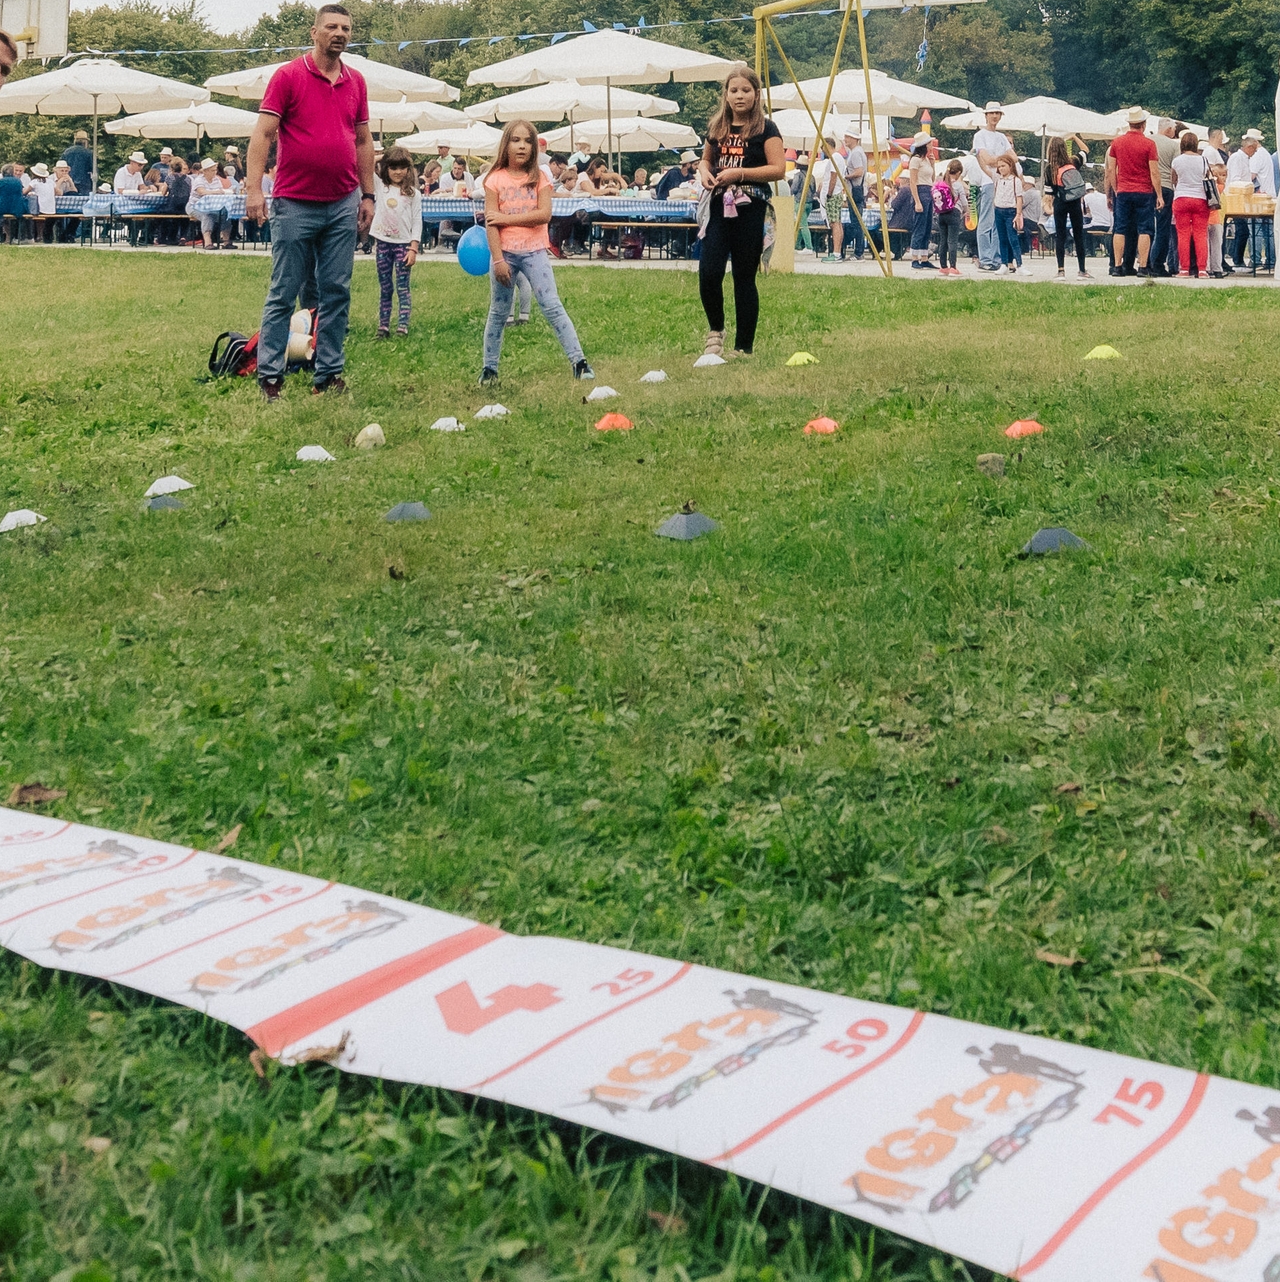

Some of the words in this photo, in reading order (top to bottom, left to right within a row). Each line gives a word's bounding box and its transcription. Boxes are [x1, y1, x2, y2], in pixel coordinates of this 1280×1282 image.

[718, 155, 745, 168] HEART
[589, 967, 656, 997] 25
[434, 980, 564, 1036] 4
[821, 1017, 890, 1060] 50
[1092, 1077, 1166, 1128] 75
